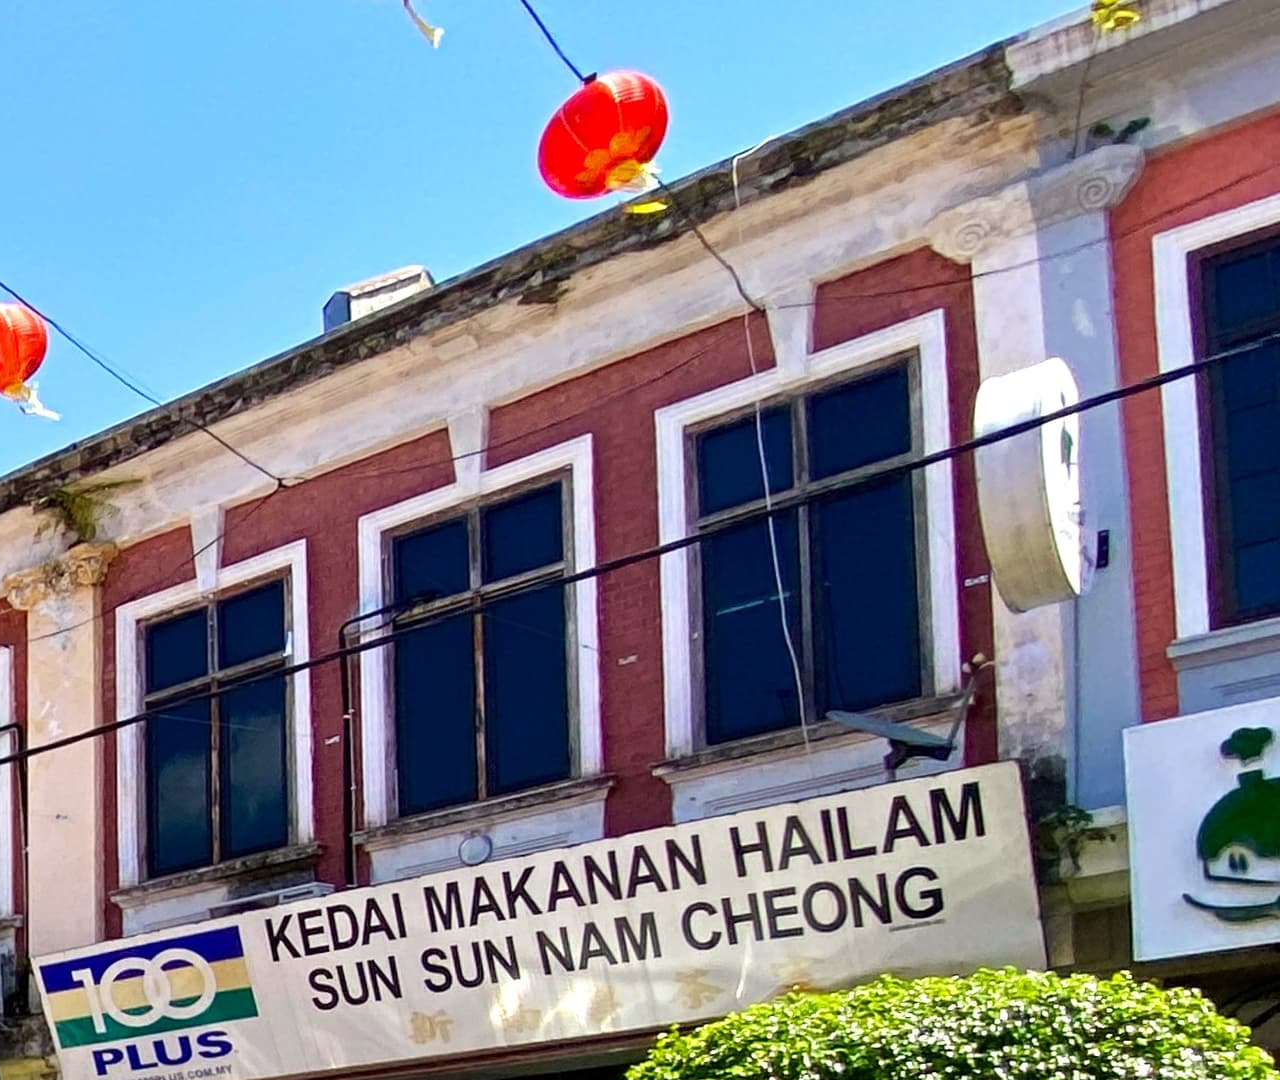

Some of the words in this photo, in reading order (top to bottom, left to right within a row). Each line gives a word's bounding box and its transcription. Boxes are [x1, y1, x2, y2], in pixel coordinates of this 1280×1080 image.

[265, 893, 407, 962] KEDAI
[423, 834, 707, 933] MAKANAN
[729, 781, 986, 878] HAILAM
[71, 948, 217, 1034] 100
[309, 955, 402, 1011] SUN
[421, 935, 521, 993] SUN
[536, 911, 662, 975] NAM
[681, 866, 945, 951] CHEONG
[92, 1031, 233, 1076] PLUS
